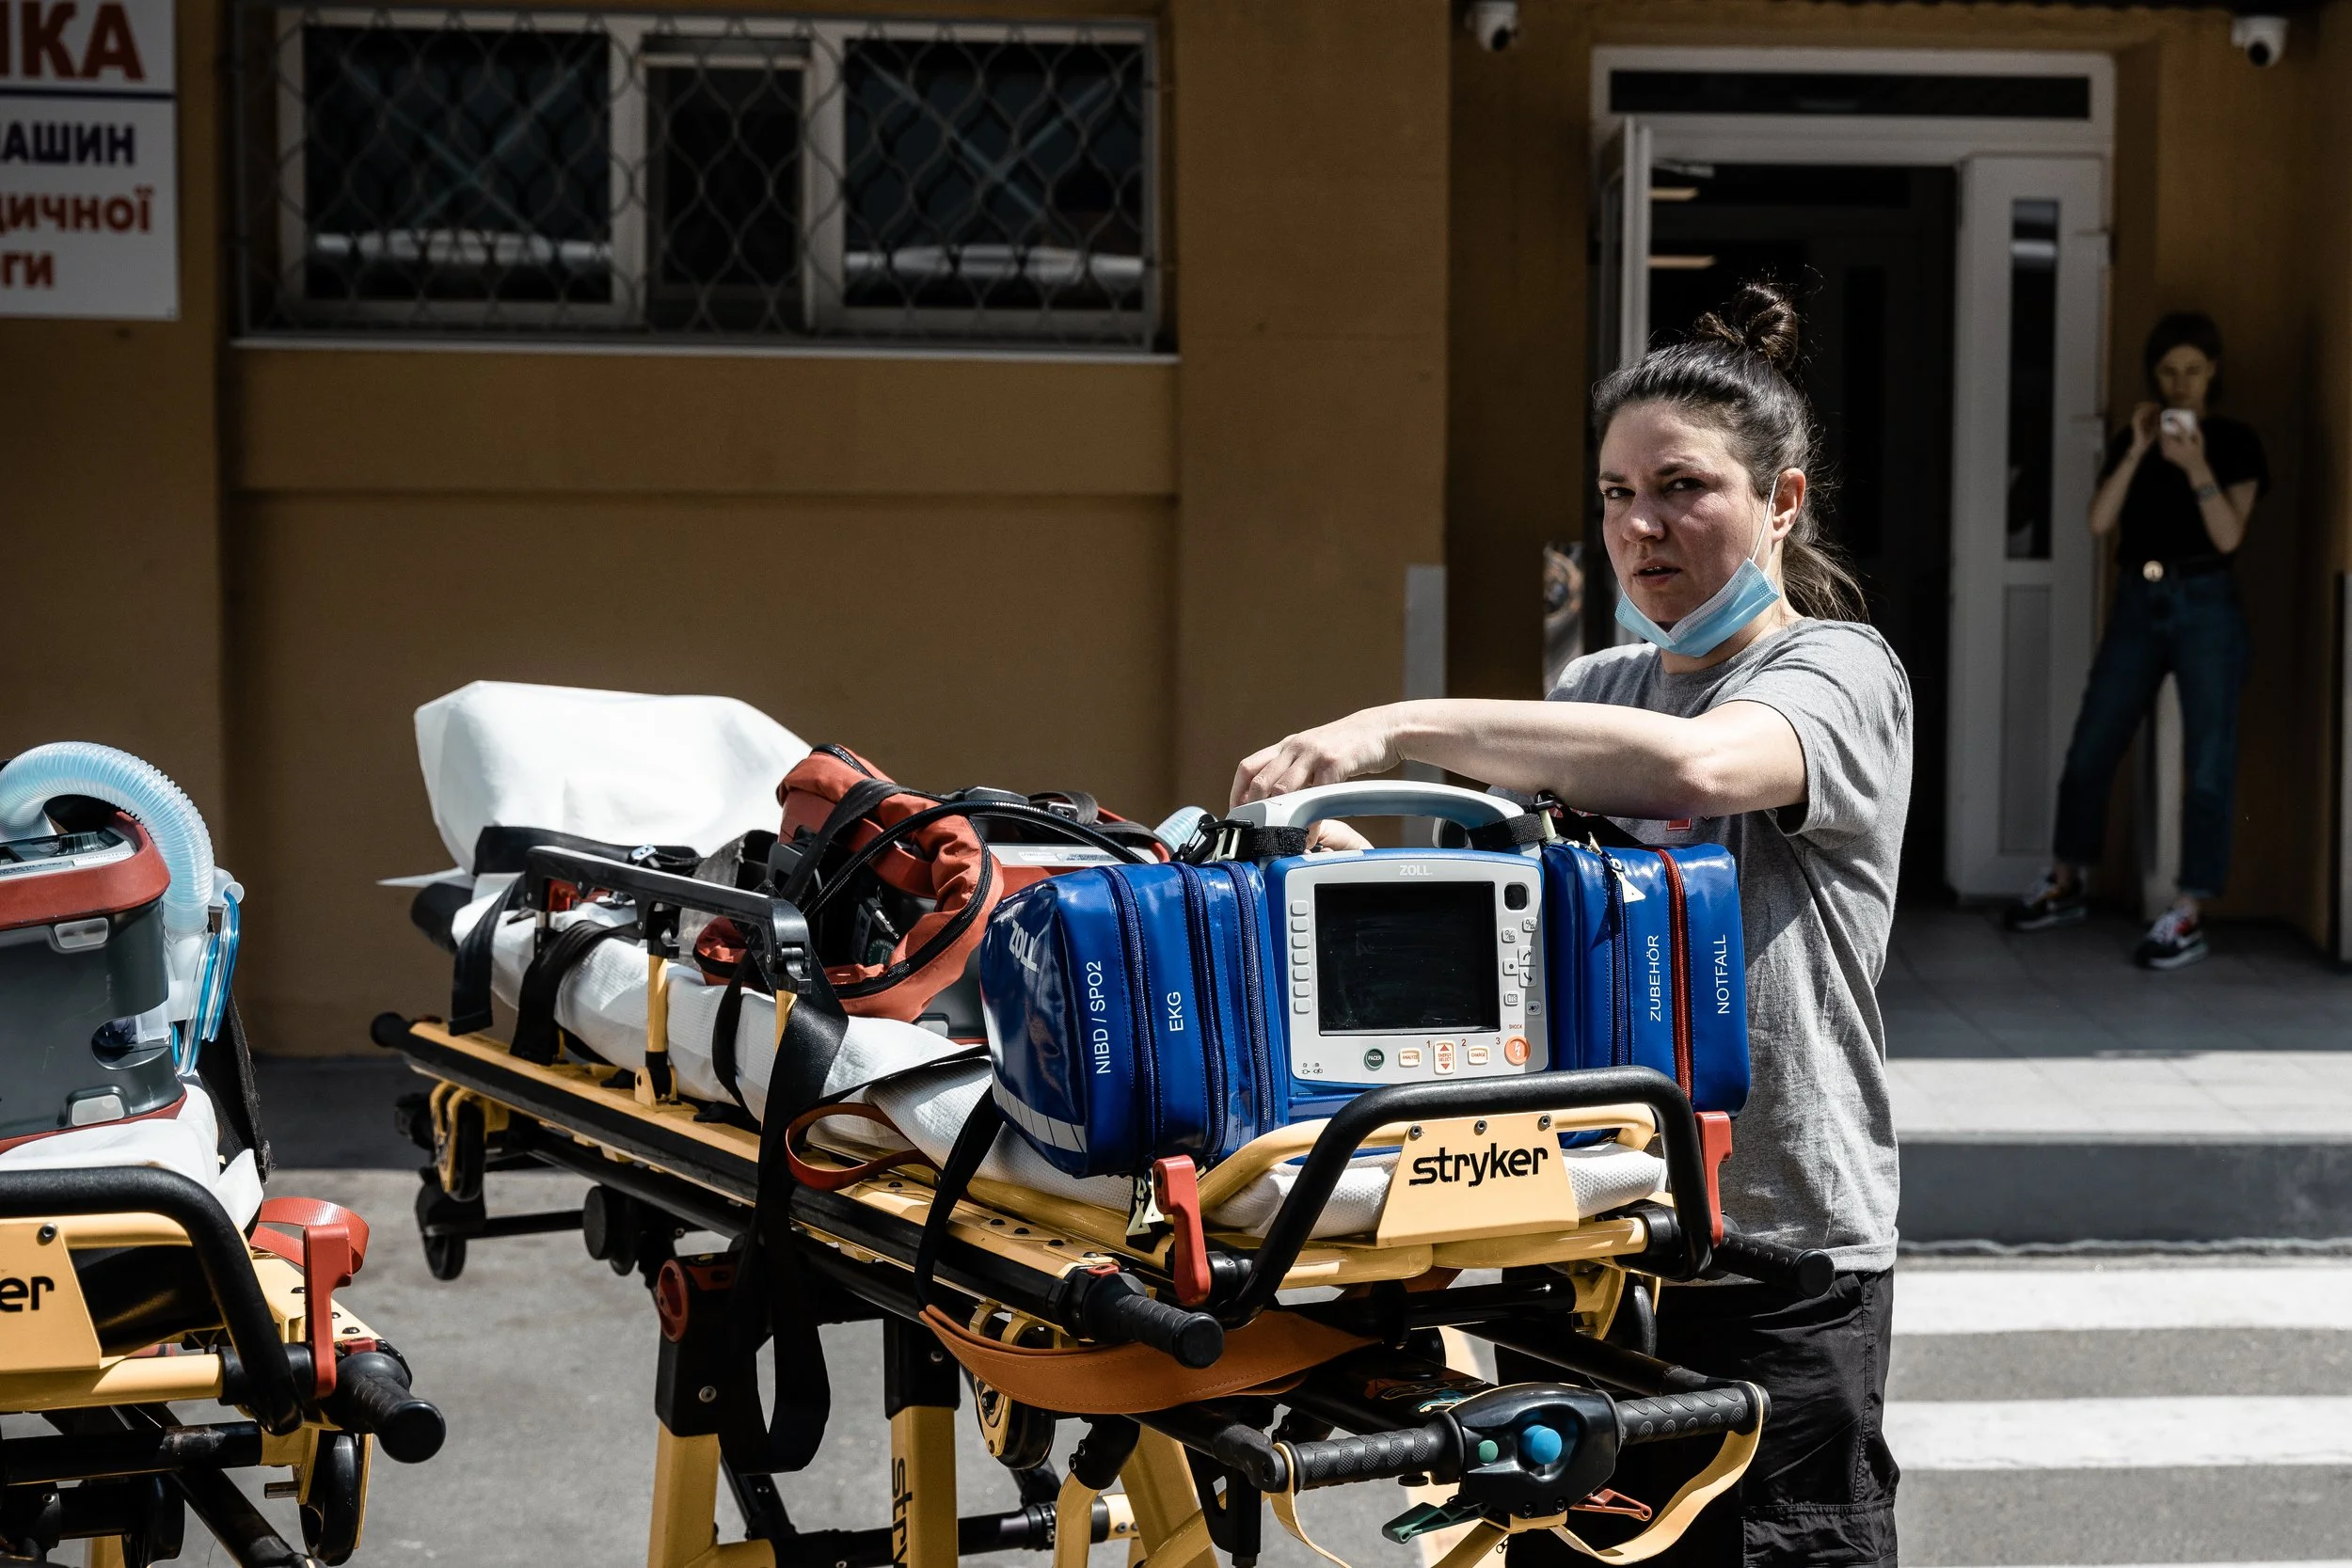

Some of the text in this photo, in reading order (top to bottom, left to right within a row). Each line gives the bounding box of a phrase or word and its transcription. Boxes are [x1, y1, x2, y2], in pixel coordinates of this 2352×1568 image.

[0, 185, 154, 233] ичної
[1400, 864, 1430, 877] ZOLL
[1009, 919, 1038, 973] ZOLL
[1086, 960, 1106, 1012] SPO2
[1646, 935, 1661, 1022] ZUBEHÖR
[1713, 934, 1730, 1014] NOTFALL
[1167, 991, 1184, 1031] EKG
[1092, 1028, 1111, 1074] NIBD
[1461, 1038, 1467, 1047] 2
[1495, 1037, 1501, 1046] 3
[1408, 1142, 1549, 1188] stryker
[0, 1275, 55, 1313] er
